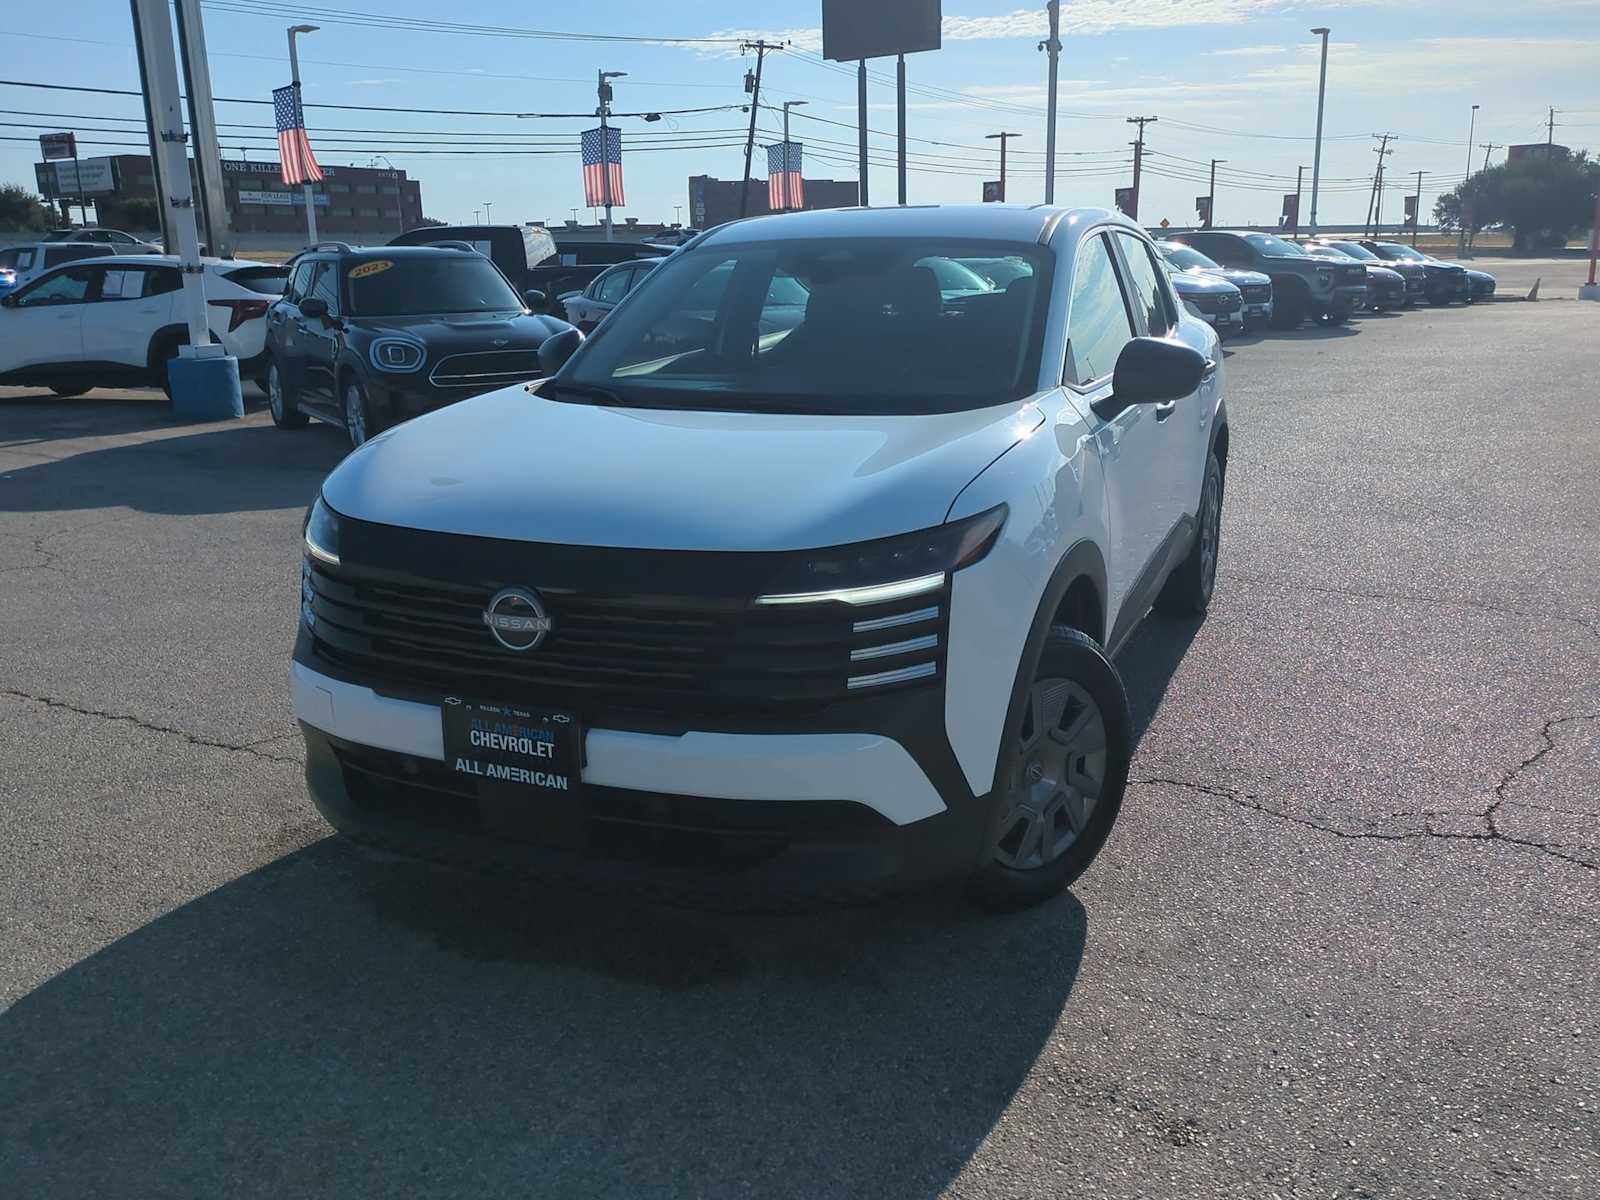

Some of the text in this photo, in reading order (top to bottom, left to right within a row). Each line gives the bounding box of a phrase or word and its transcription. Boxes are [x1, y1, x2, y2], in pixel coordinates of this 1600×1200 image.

[224, 162, 247, 173] ONE
[483, 612, 552, 631] NISSAN
[470, 729, 555, 759] CHEVROLET
[455, 757, 568, 791] ALL AMERICAN
